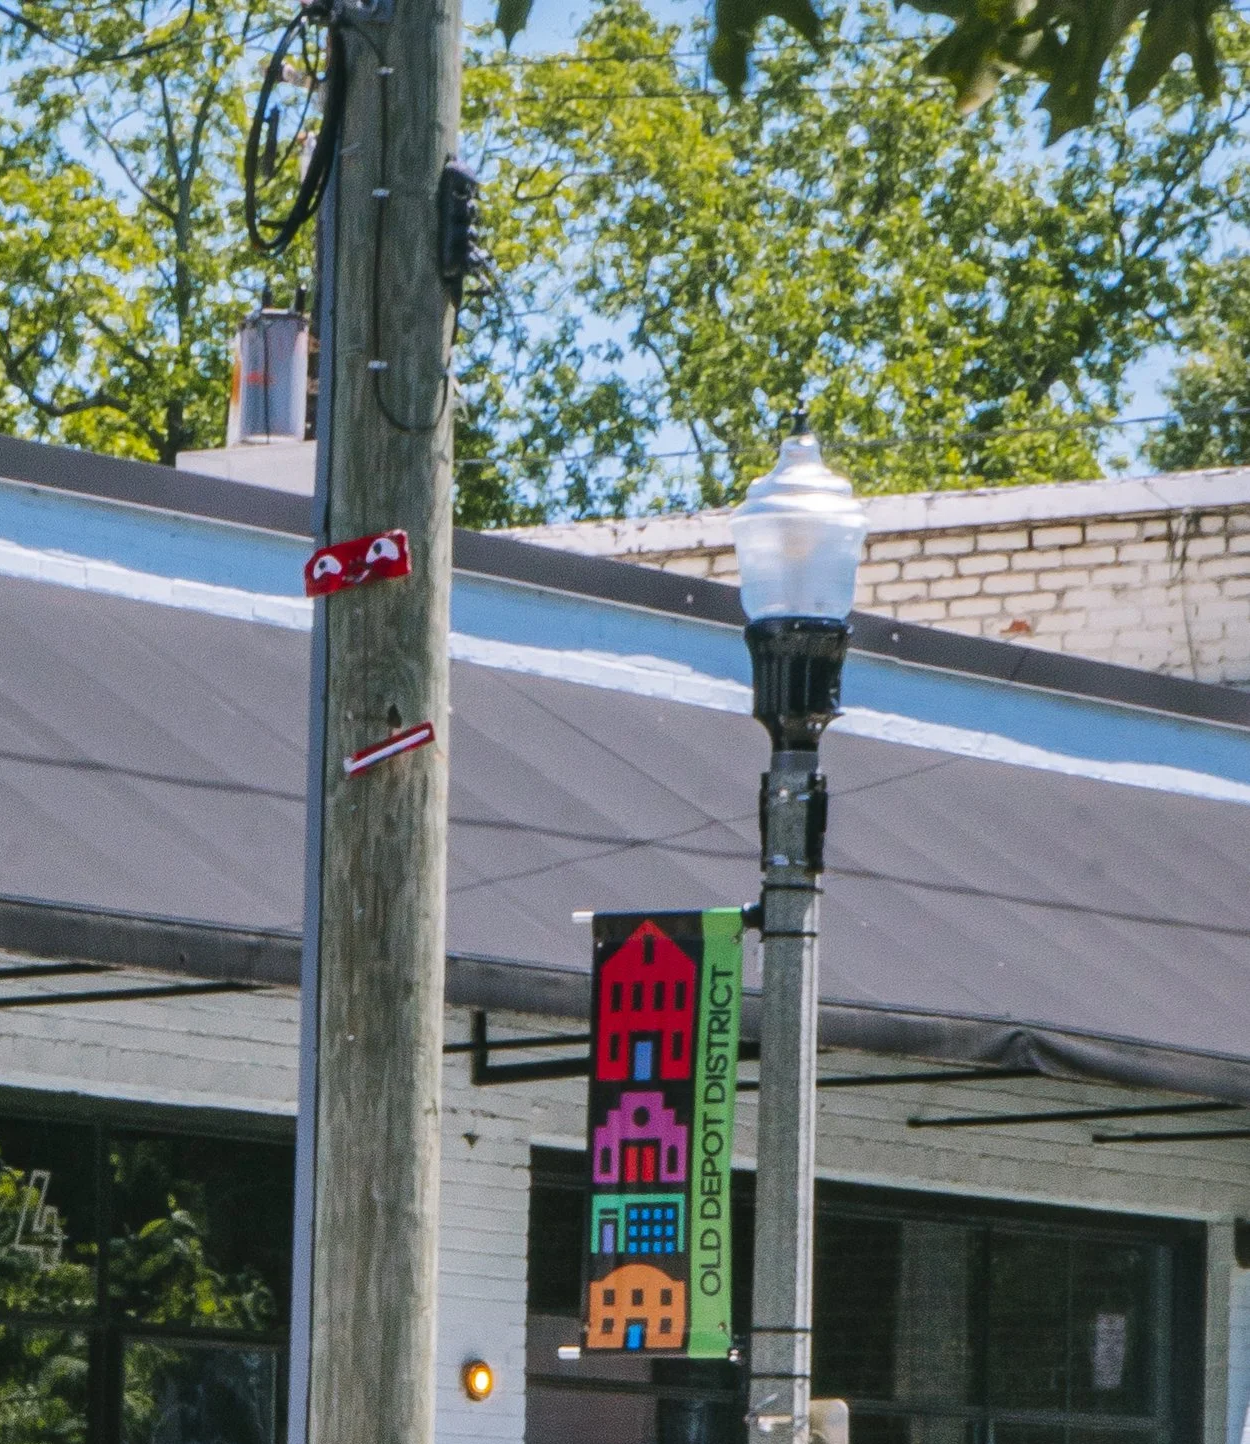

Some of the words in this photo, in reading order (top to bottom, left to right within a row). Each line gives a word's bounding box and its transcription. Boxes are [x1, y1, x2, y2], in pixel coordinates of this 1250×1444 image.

[705, 964, 734, 1105] DISTRICT
[700, 1112, 724, 1222] DEPOT
[699, 1228, 722, 1297] OLD
